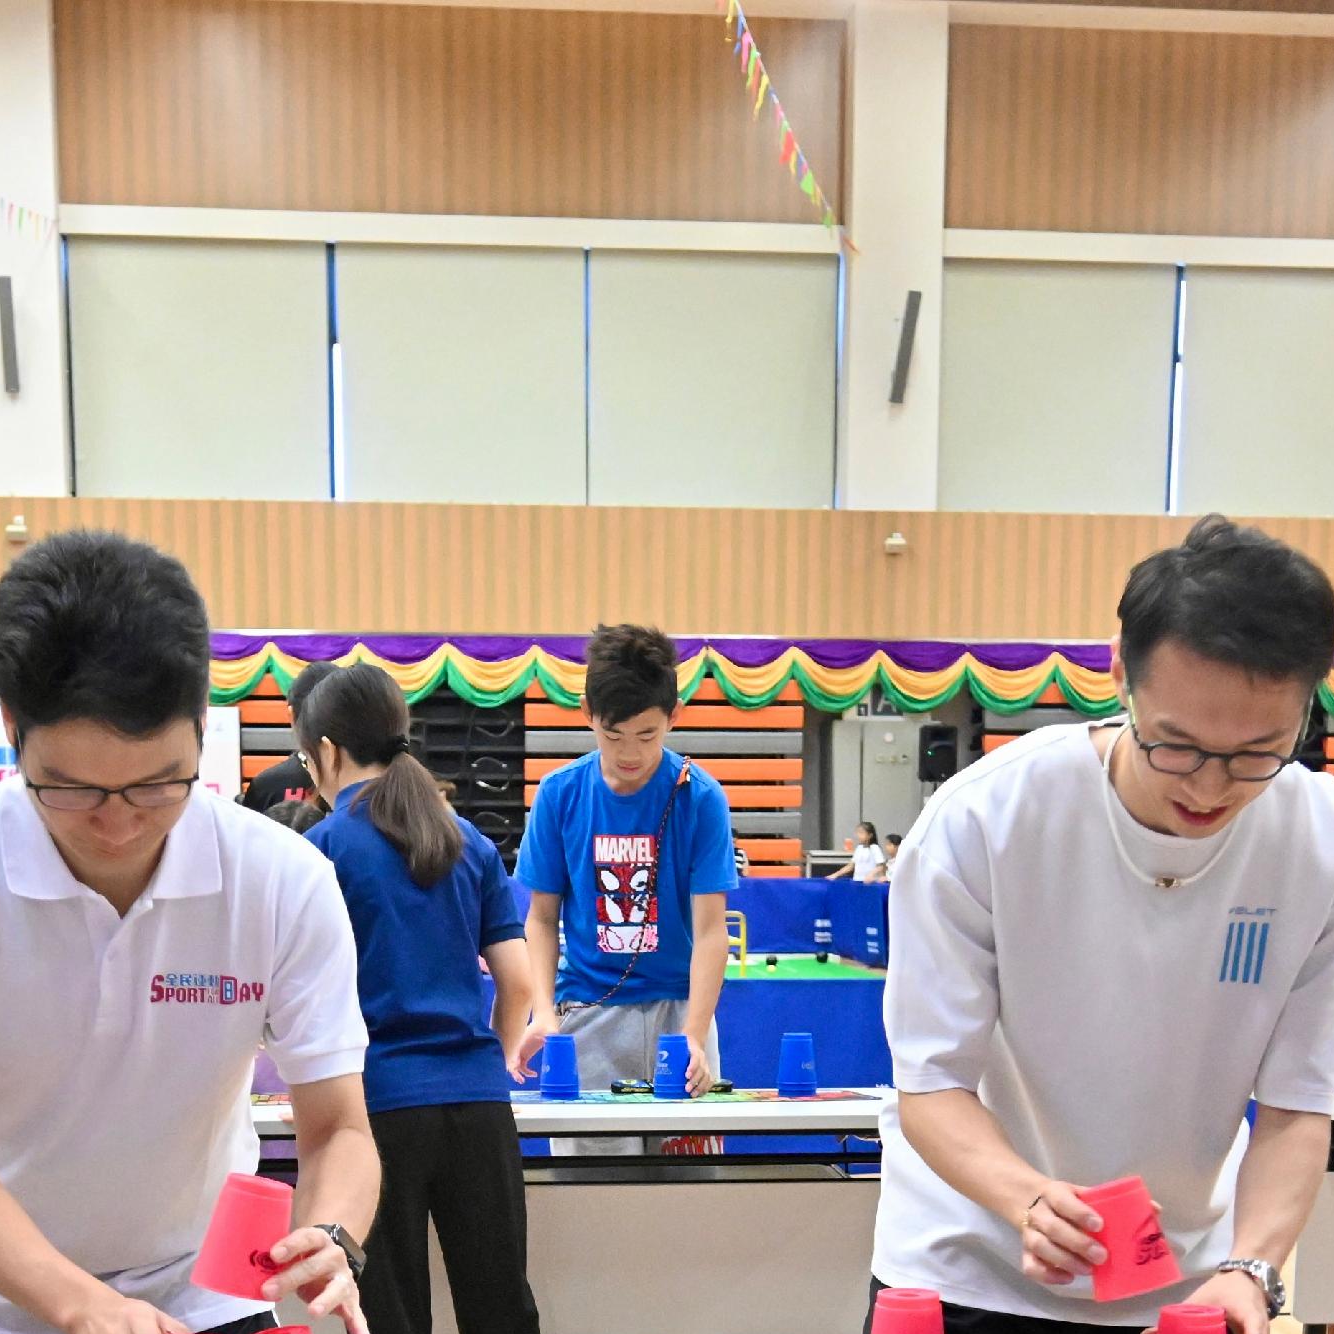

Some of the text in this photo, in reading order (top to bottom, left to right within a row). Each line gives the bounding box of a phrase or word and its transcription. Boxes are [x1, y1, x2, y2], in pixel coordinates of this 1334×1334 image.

[595, 836, 654, 864] MARVEL
[150, 974, 207, 1003] SPORT
[219, 974, 264, 1005] DAY
